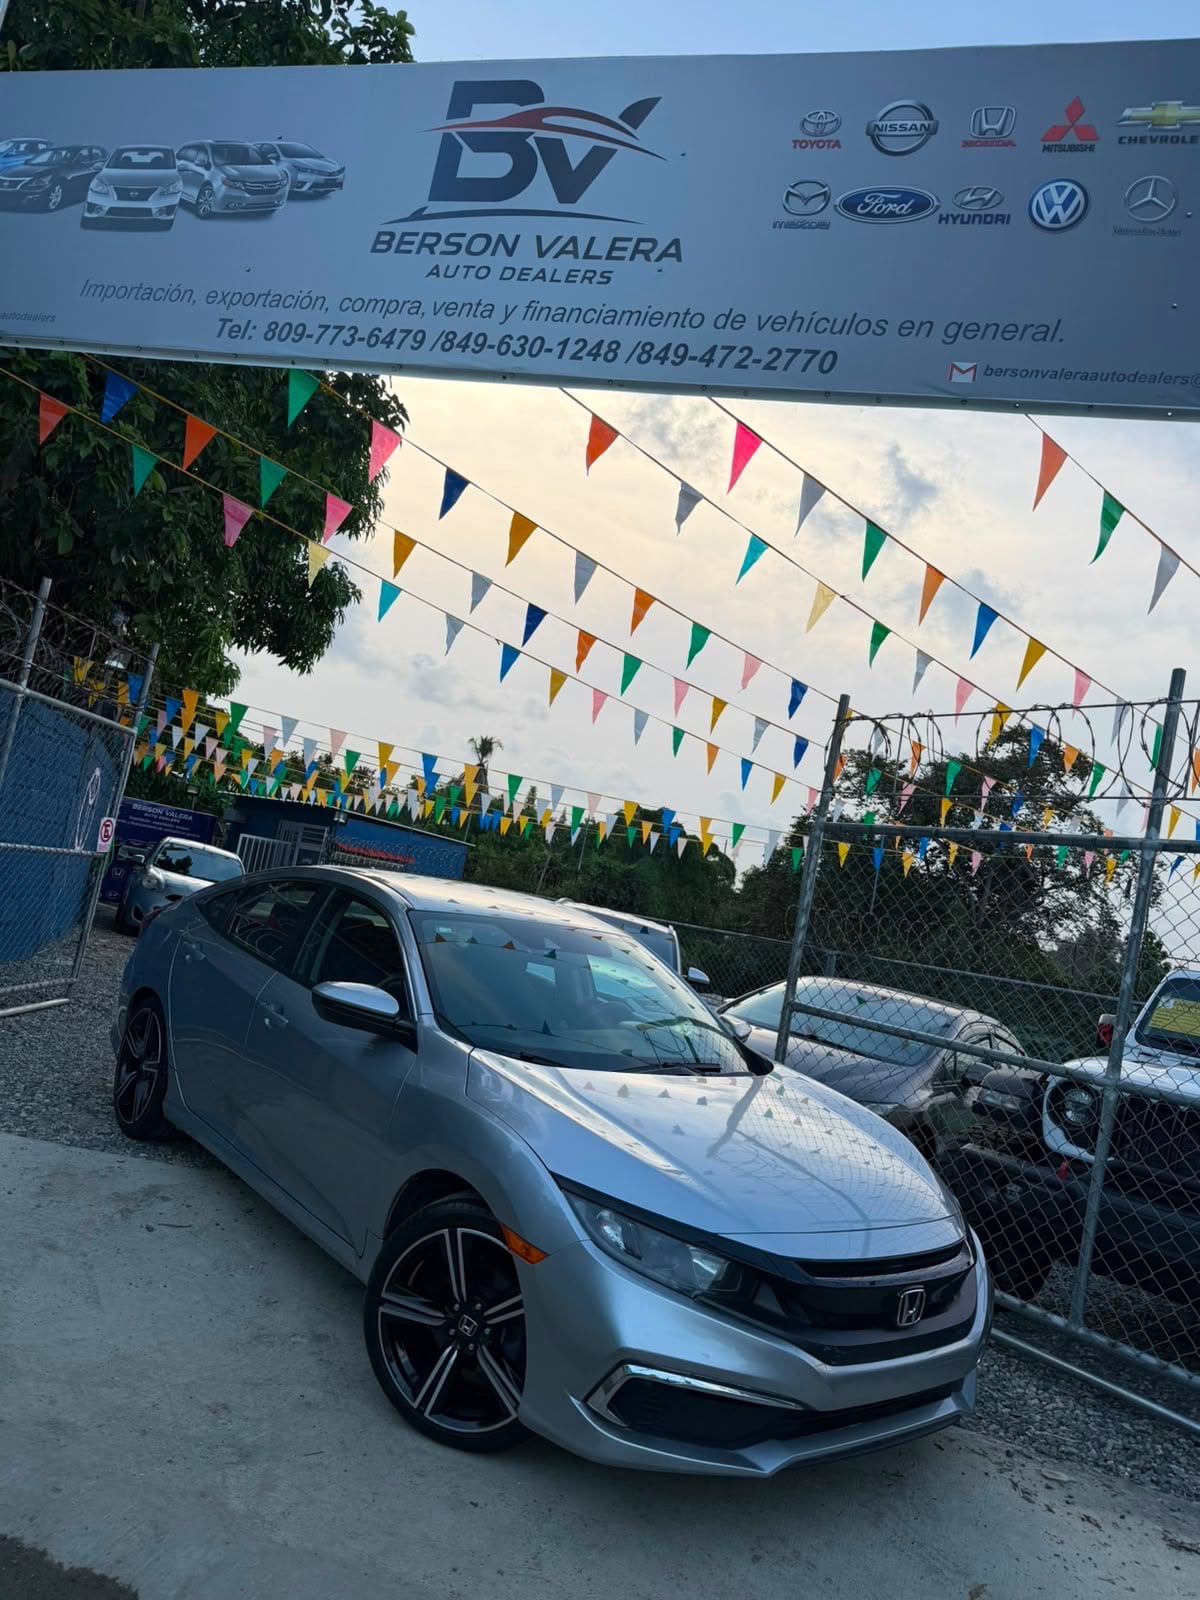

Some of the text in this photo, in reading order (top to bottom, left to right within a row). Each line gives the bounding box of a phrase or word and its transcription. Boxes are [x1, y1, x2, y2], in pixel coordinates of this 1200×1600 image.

[873, 123, 931, 133] NISSAN
[792, 139, 842, 149] TOYOTA
[1042, 143, 1096, 153] MITSUBISHI
[857, 193, 914, 214] Ford
[938, 214, 1011, 225] HYUNDAI
[370, 231, 683, 263] BERSON VALERA
[426, 265, 615, 285] AUTO DEALERS
[80, 279, 1066, 345] Importación, exportación, compra, venta y financiamiento de vehículos en general.
[216, 318, 258, 340] Tel:
[263, 321, 427, 351] 809-773-6479
[132, 803, 193, 821] BERSON VALERA
